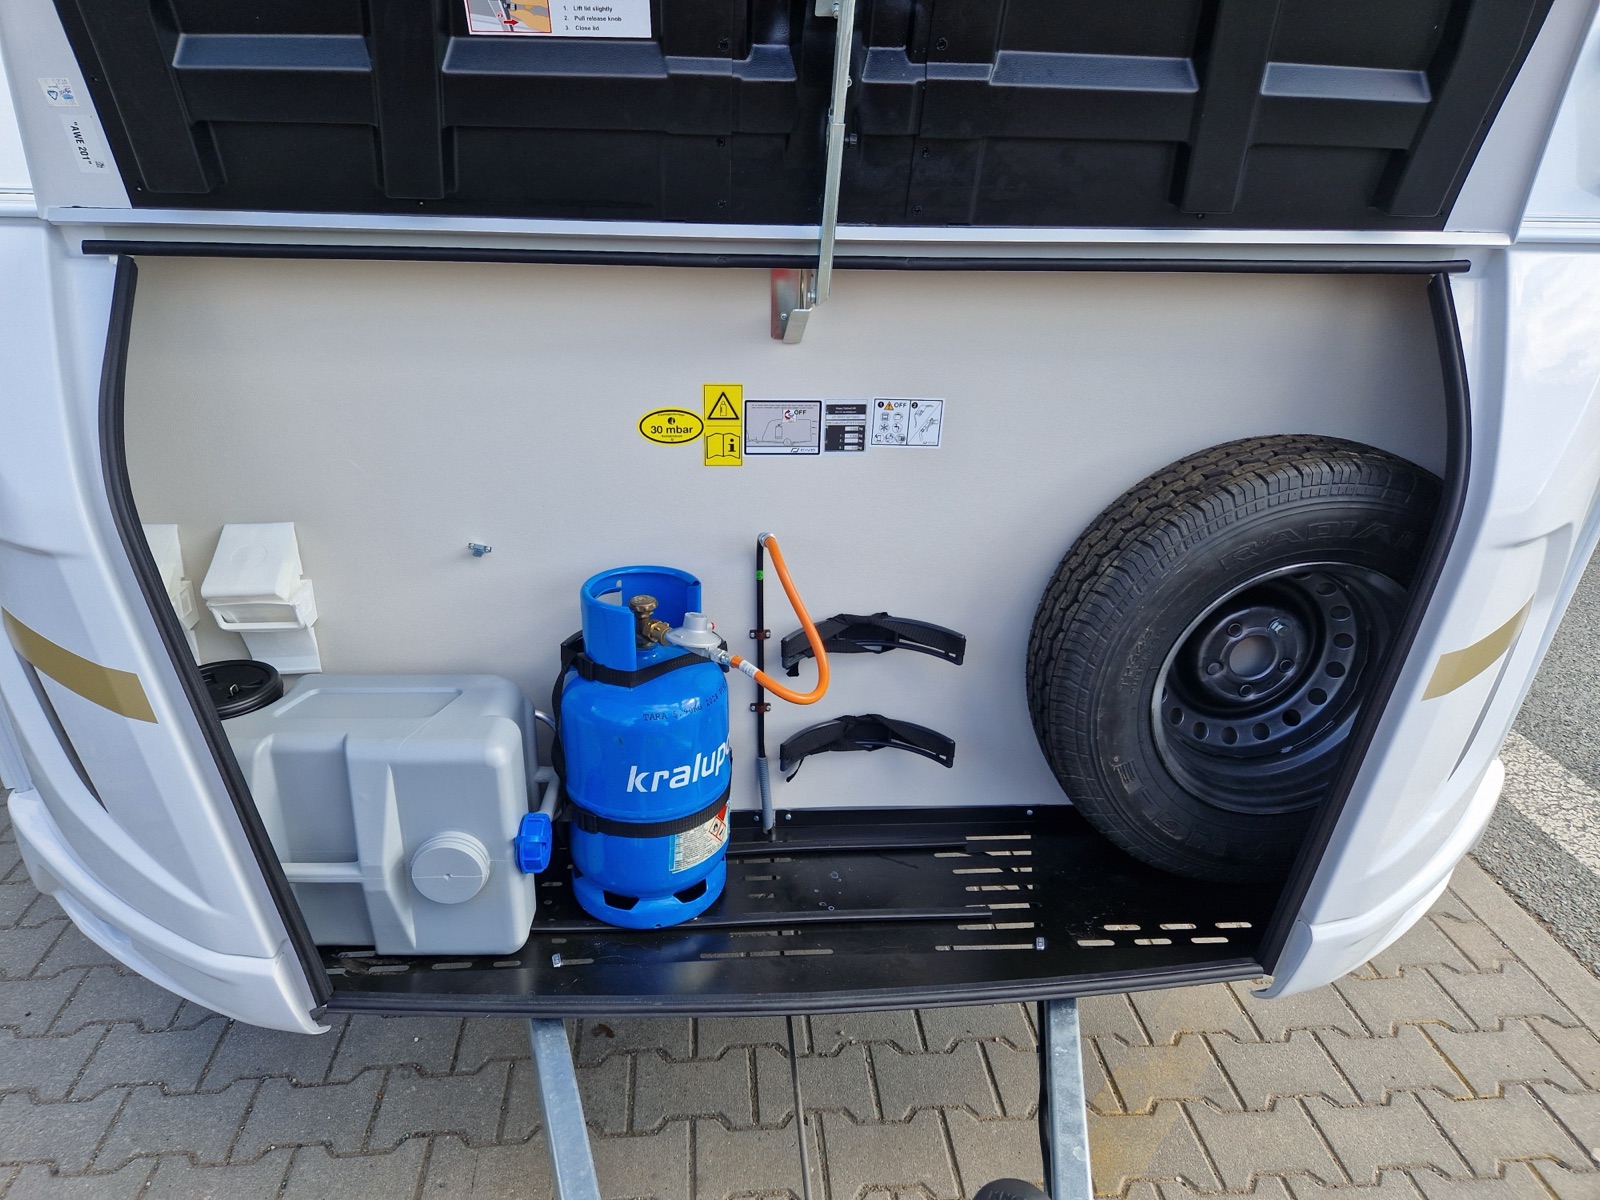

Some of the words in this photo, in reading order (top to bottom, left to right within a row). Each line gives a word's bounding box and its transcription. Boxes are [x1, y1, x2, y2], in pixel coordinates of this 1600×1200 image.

[650, 425, 663, 434] 30
[666, 425, 693, 434] mbar
[642, 712, 668, 721] TARA
